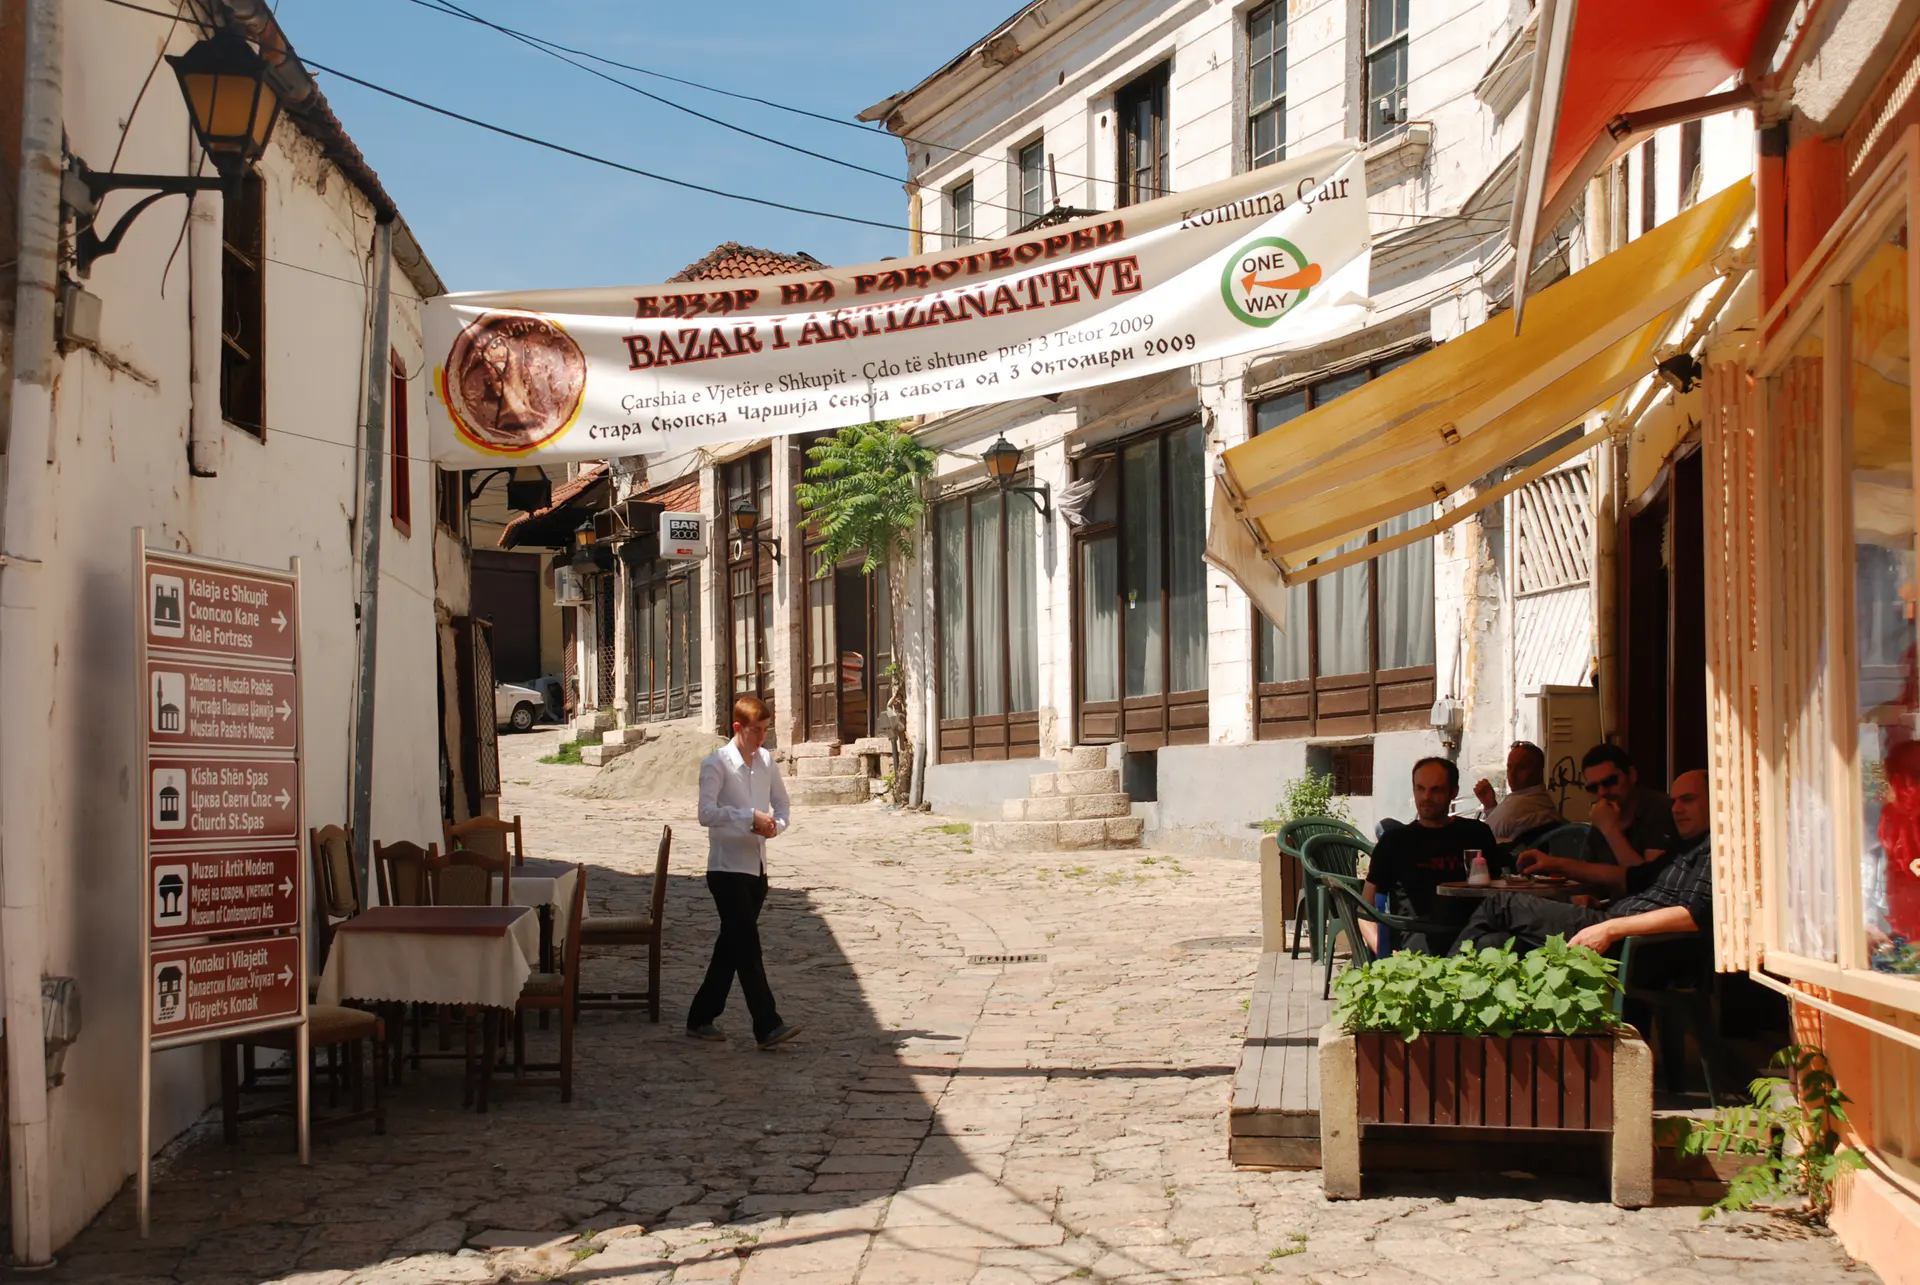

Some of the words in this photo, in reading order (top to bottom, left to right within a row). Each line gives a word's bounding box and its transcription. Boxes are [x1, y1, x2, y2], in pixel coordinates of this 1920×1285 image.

[1179, 192, 1287, 231] Komuna
[1296, 175, 1350, 215] Çair
[1241, 252, 1285, 273] ONE
[621, 321, 764, 371] BAZAR
[770, 317, 791, 350] I
[797, 254, 1144, 347] ARTIZANATEVE
[1244, 292, 1289, 314] WAY
[1143, 333, 1197, 357] 2009
[620, 389, 687, 416] Çarshia
[692, 391, 701, 403] e
[705, 380, 760, 405] Vjetër
[764, 381, 774, 394] e
[778, 367, 848, 393] Shkupit
[862, 358, 901, 385] Çdo
[905, 357, 923, 374] të
[927, 350, 989, 371] shtune
[997, 338, 1033, 362] prej
[1038, 334, 1050, 353] 3
[1054, 328, 1104, 348] Tetor
[1108, 313, 1155, 338] 2009
[671, 520, 698, 530] BAR
[671, 529, 699, 540] 2000
[189, 578, 221, 603] Kalaja
[223, 586, 230, 601] e
[231, 584, 269, 608] Shkupit
[189, 600, 233, 623] Скопско
[235, 607, 260, 627] Кале
[189, 624, 212, 644] Kale
[213, 627, 253, 648] Fortress
[189, 673, 216, 692] Xhamia
[217, 678, 222, 692] e
[223, 675, 250, 694] Mustafa
[251, 678, 274, 696] Pashës
[190, 696, 221, 719] Мустафа
[190, 719, 219, 737] Mustafa
[220, 720, 247, 739] Pasha's
[248, 722, 275, 744] Mosque
[191, 767, 218, 786] Kisha
[220, 767, 244, 786] Shën
[246, 768, 269, 789] Spas
[191, 790, 220, 812] Црква
[222, 790, 249, 808] Свети
[251, 790, 273, 808] Спас
[191, 812, 226, 831] Church
[228, 812, 265, 834] St.Spas
[191, 861, 218, 879] Muzeu
[220, 860, 224, 878] i
[225, 859, 244, 877] Artit
[245, 858, 275, 876] Modern
[191, 884, 211, 907] Музеј
[211, 887, 220, 901] на
[191, 908, 215, 926] Museum
[216, 905, 223, 923] of
[223, 905, 262, 925] Contemporary
[262, 902, 274, 919] Arts
[189, 953, 225, 975] Konaku
[226, 952, 230, 969] i
[231, 948, 269, 971] Vilajetit
[188, 979, 226, 998] Вилаетски
[188, 999, 228, 1022] Vilayet's
[230, 993, 259, 1014] Konak
